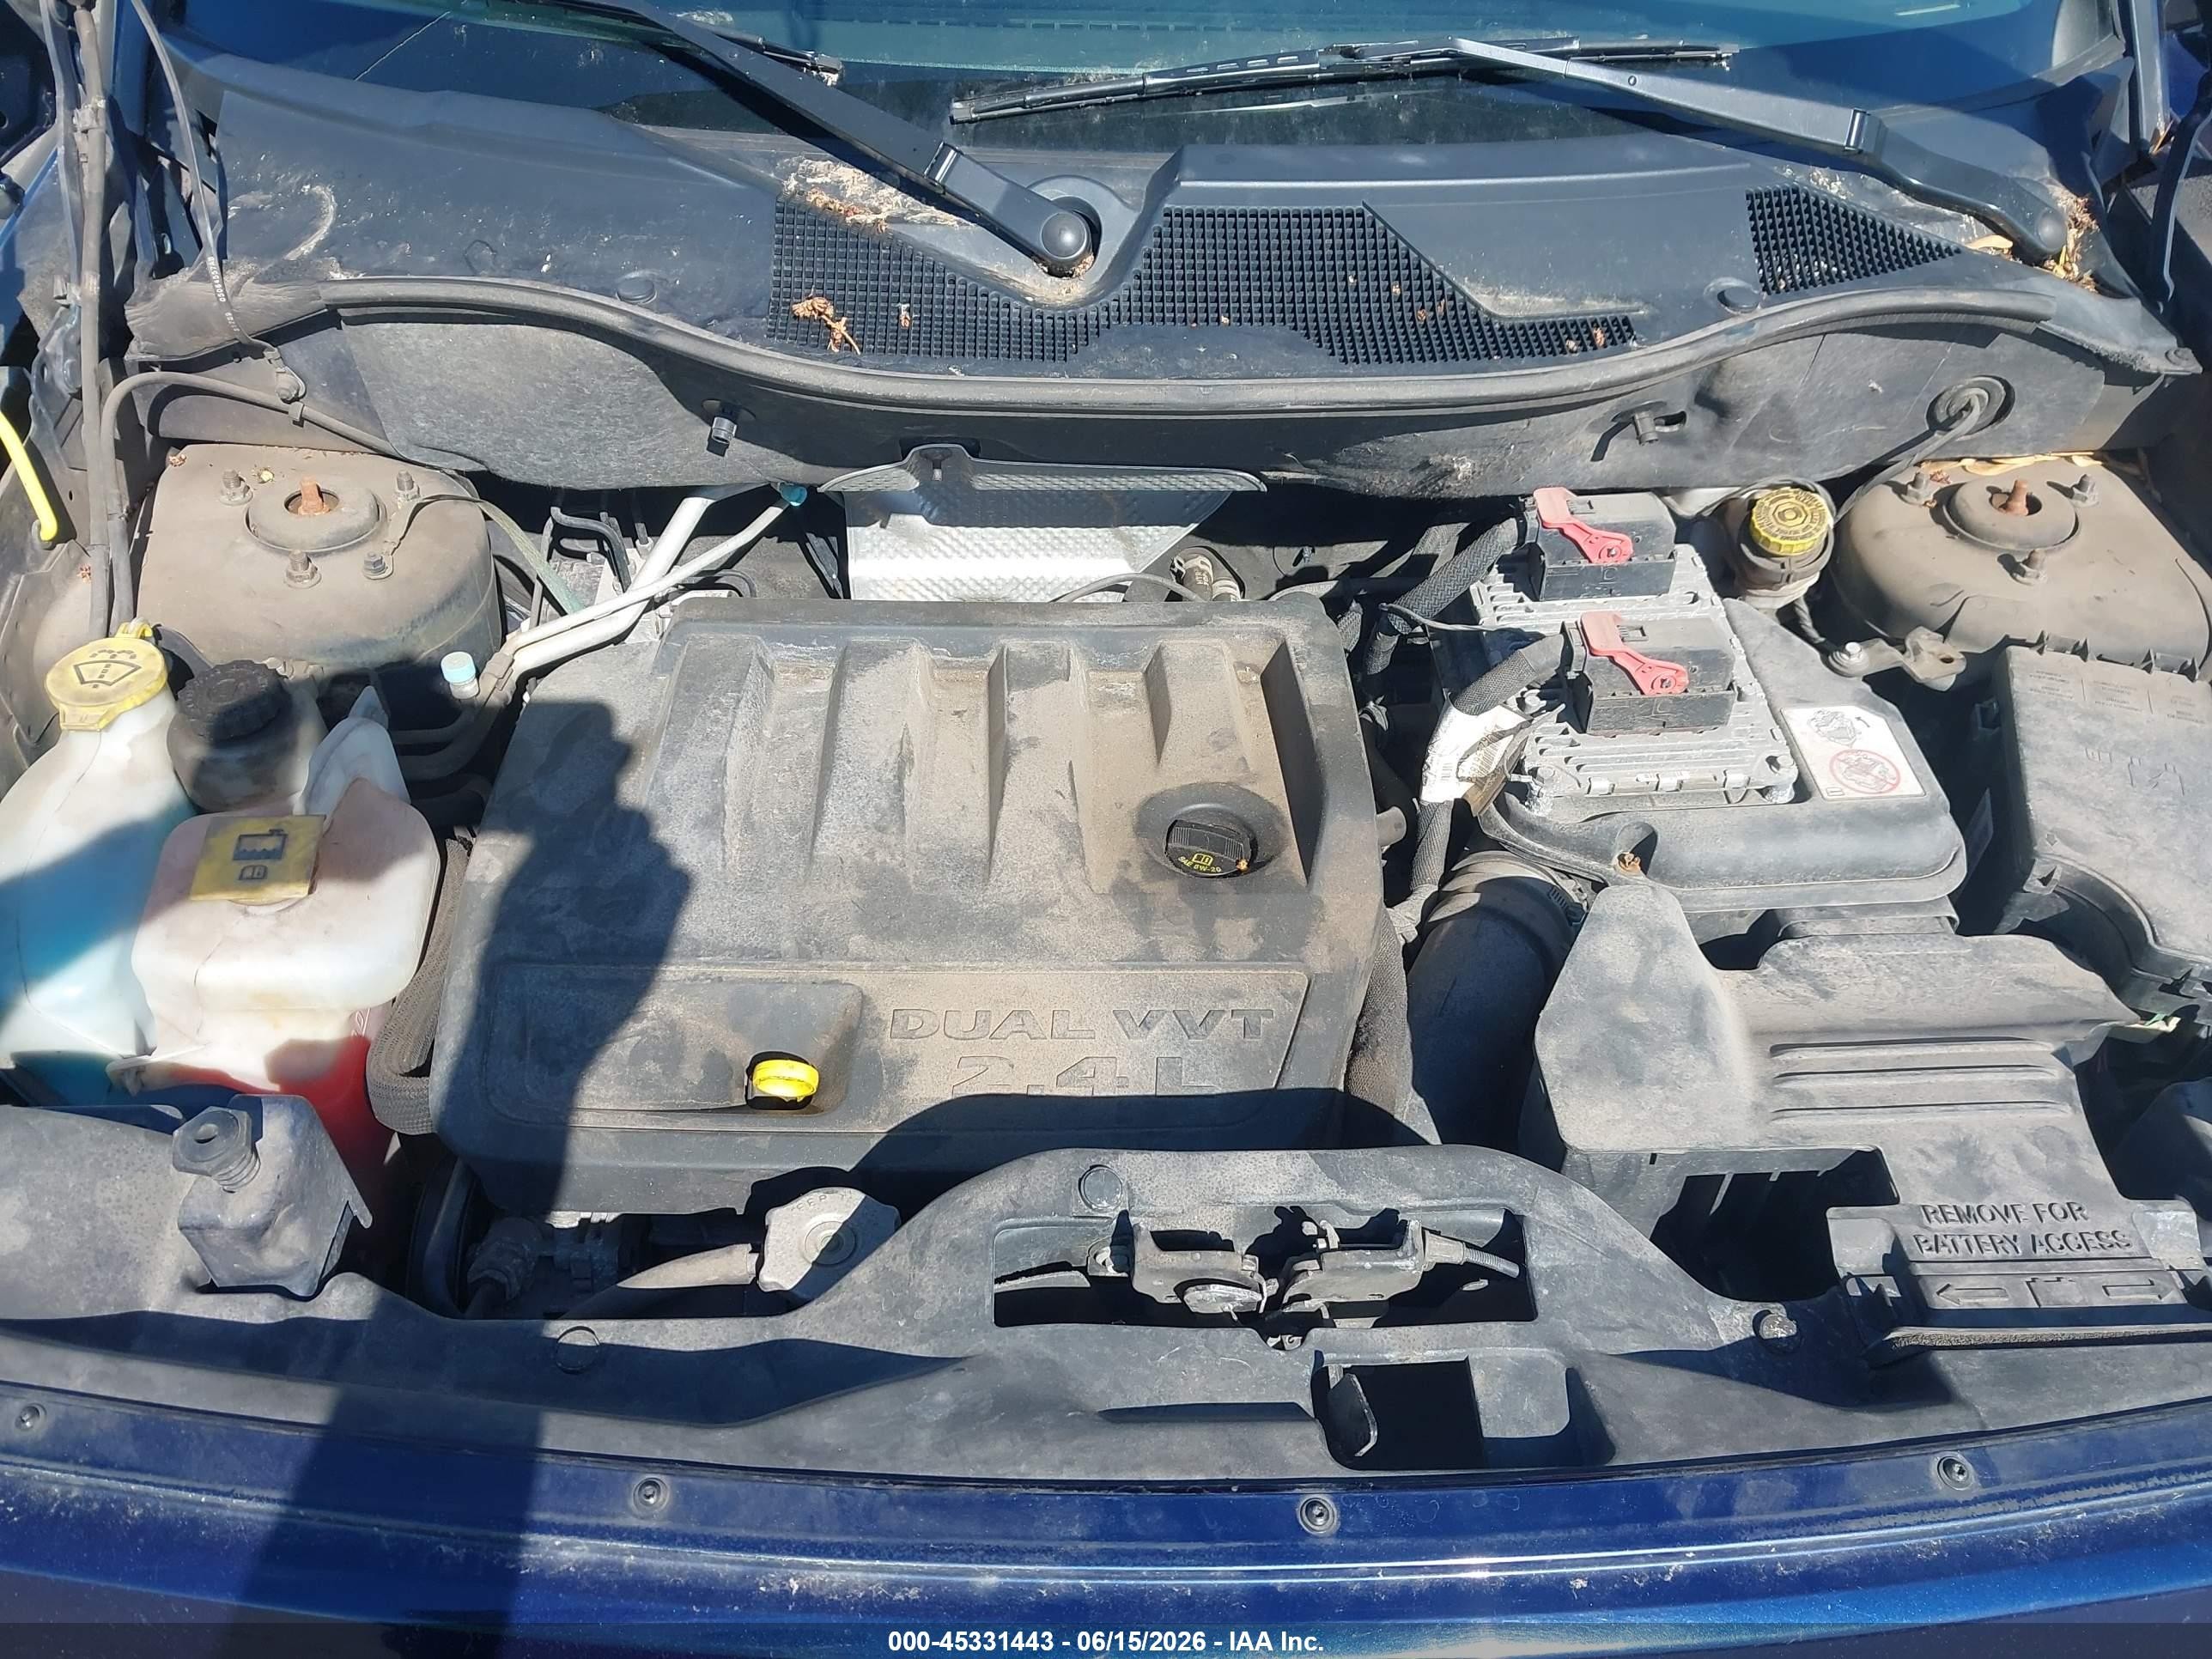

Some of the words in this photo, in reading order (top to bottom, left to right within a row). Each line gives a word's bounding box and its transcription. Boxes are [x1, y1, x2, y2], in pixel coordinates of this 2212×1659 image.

[1178, 856, 1194, 867] SAE
[890, 1009, 1096, 1040] DUAL
[1113, 1009, 1274, 1040] VVT
[1920, 1203, 2029, 1224] REMOVE
[2032, 1201, 2088, 1224] FOR
[1913, 1233, 2021, 1255] BATTERY
[2030, 1230, 2131, 1254] ACCESS
